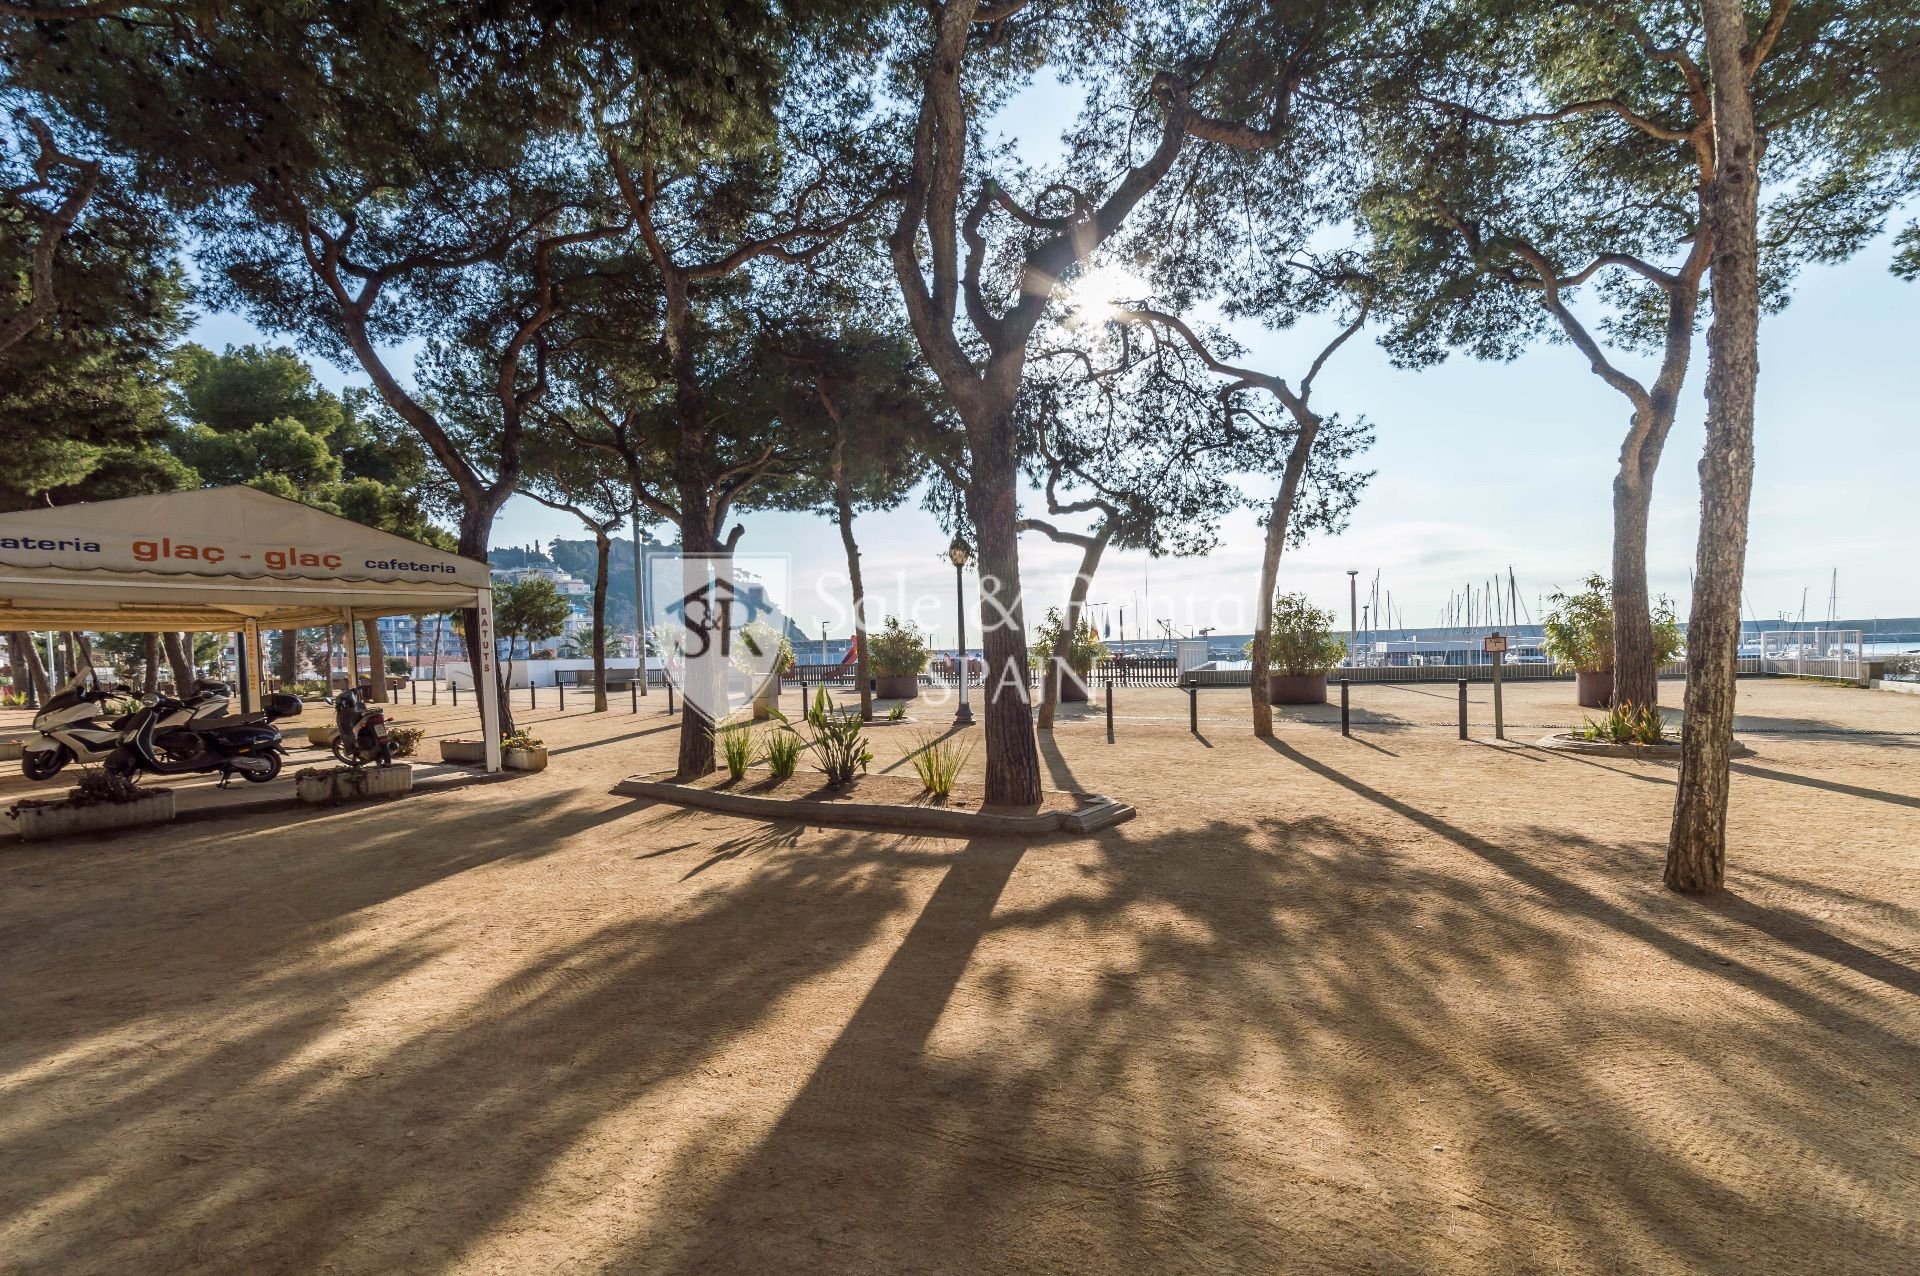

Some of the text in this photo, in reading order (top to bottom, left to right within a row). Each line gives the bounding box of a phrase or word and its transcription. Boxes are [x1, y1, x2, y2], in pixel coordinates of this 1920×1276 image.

[132, 538, 225, 564] glaç
[264, 548, 342, 571] glaç
[364, 559, 456, 574] cafeteria
[481, 607, 490, 673] BATUTS
